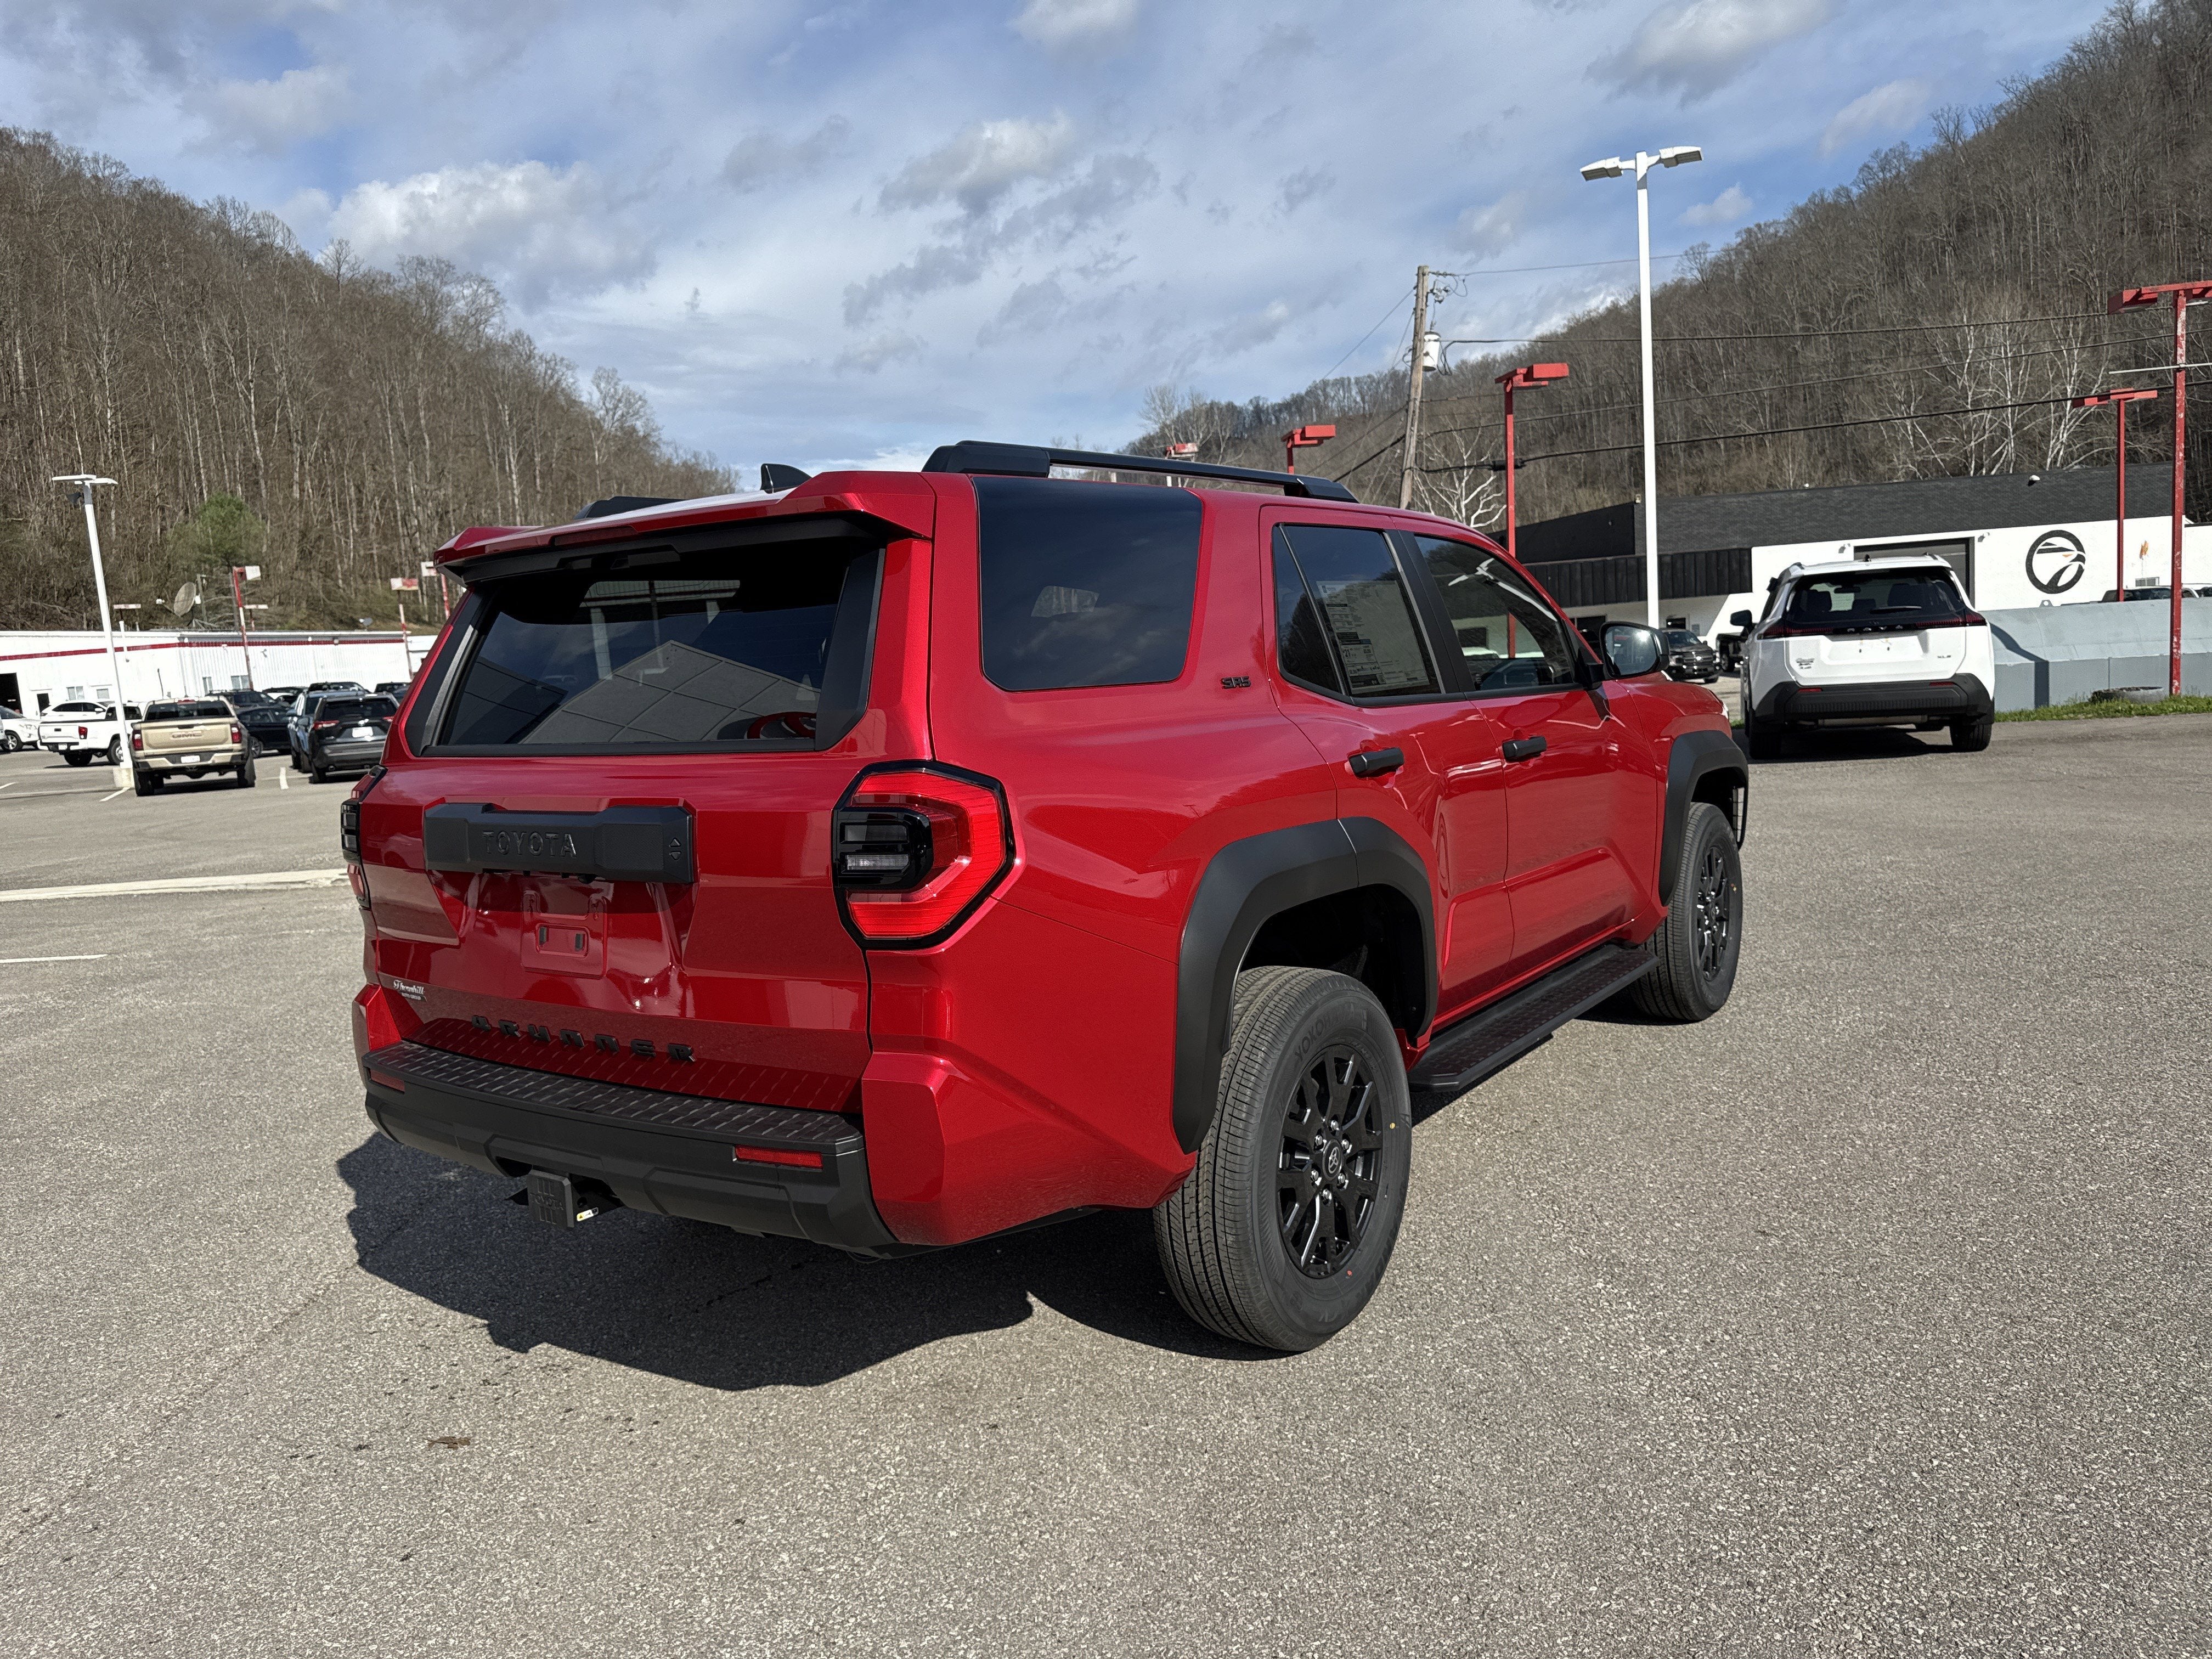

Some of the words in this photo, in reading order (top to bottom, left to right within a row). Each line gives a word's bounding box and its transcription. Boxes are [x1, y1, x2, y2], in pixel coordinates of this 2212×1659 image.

[1221, 675, 1251, 689] SR5
[482, 830, 577, 857] TOYOTA
[472, 1014, 696, 1062] 4RUNNER
